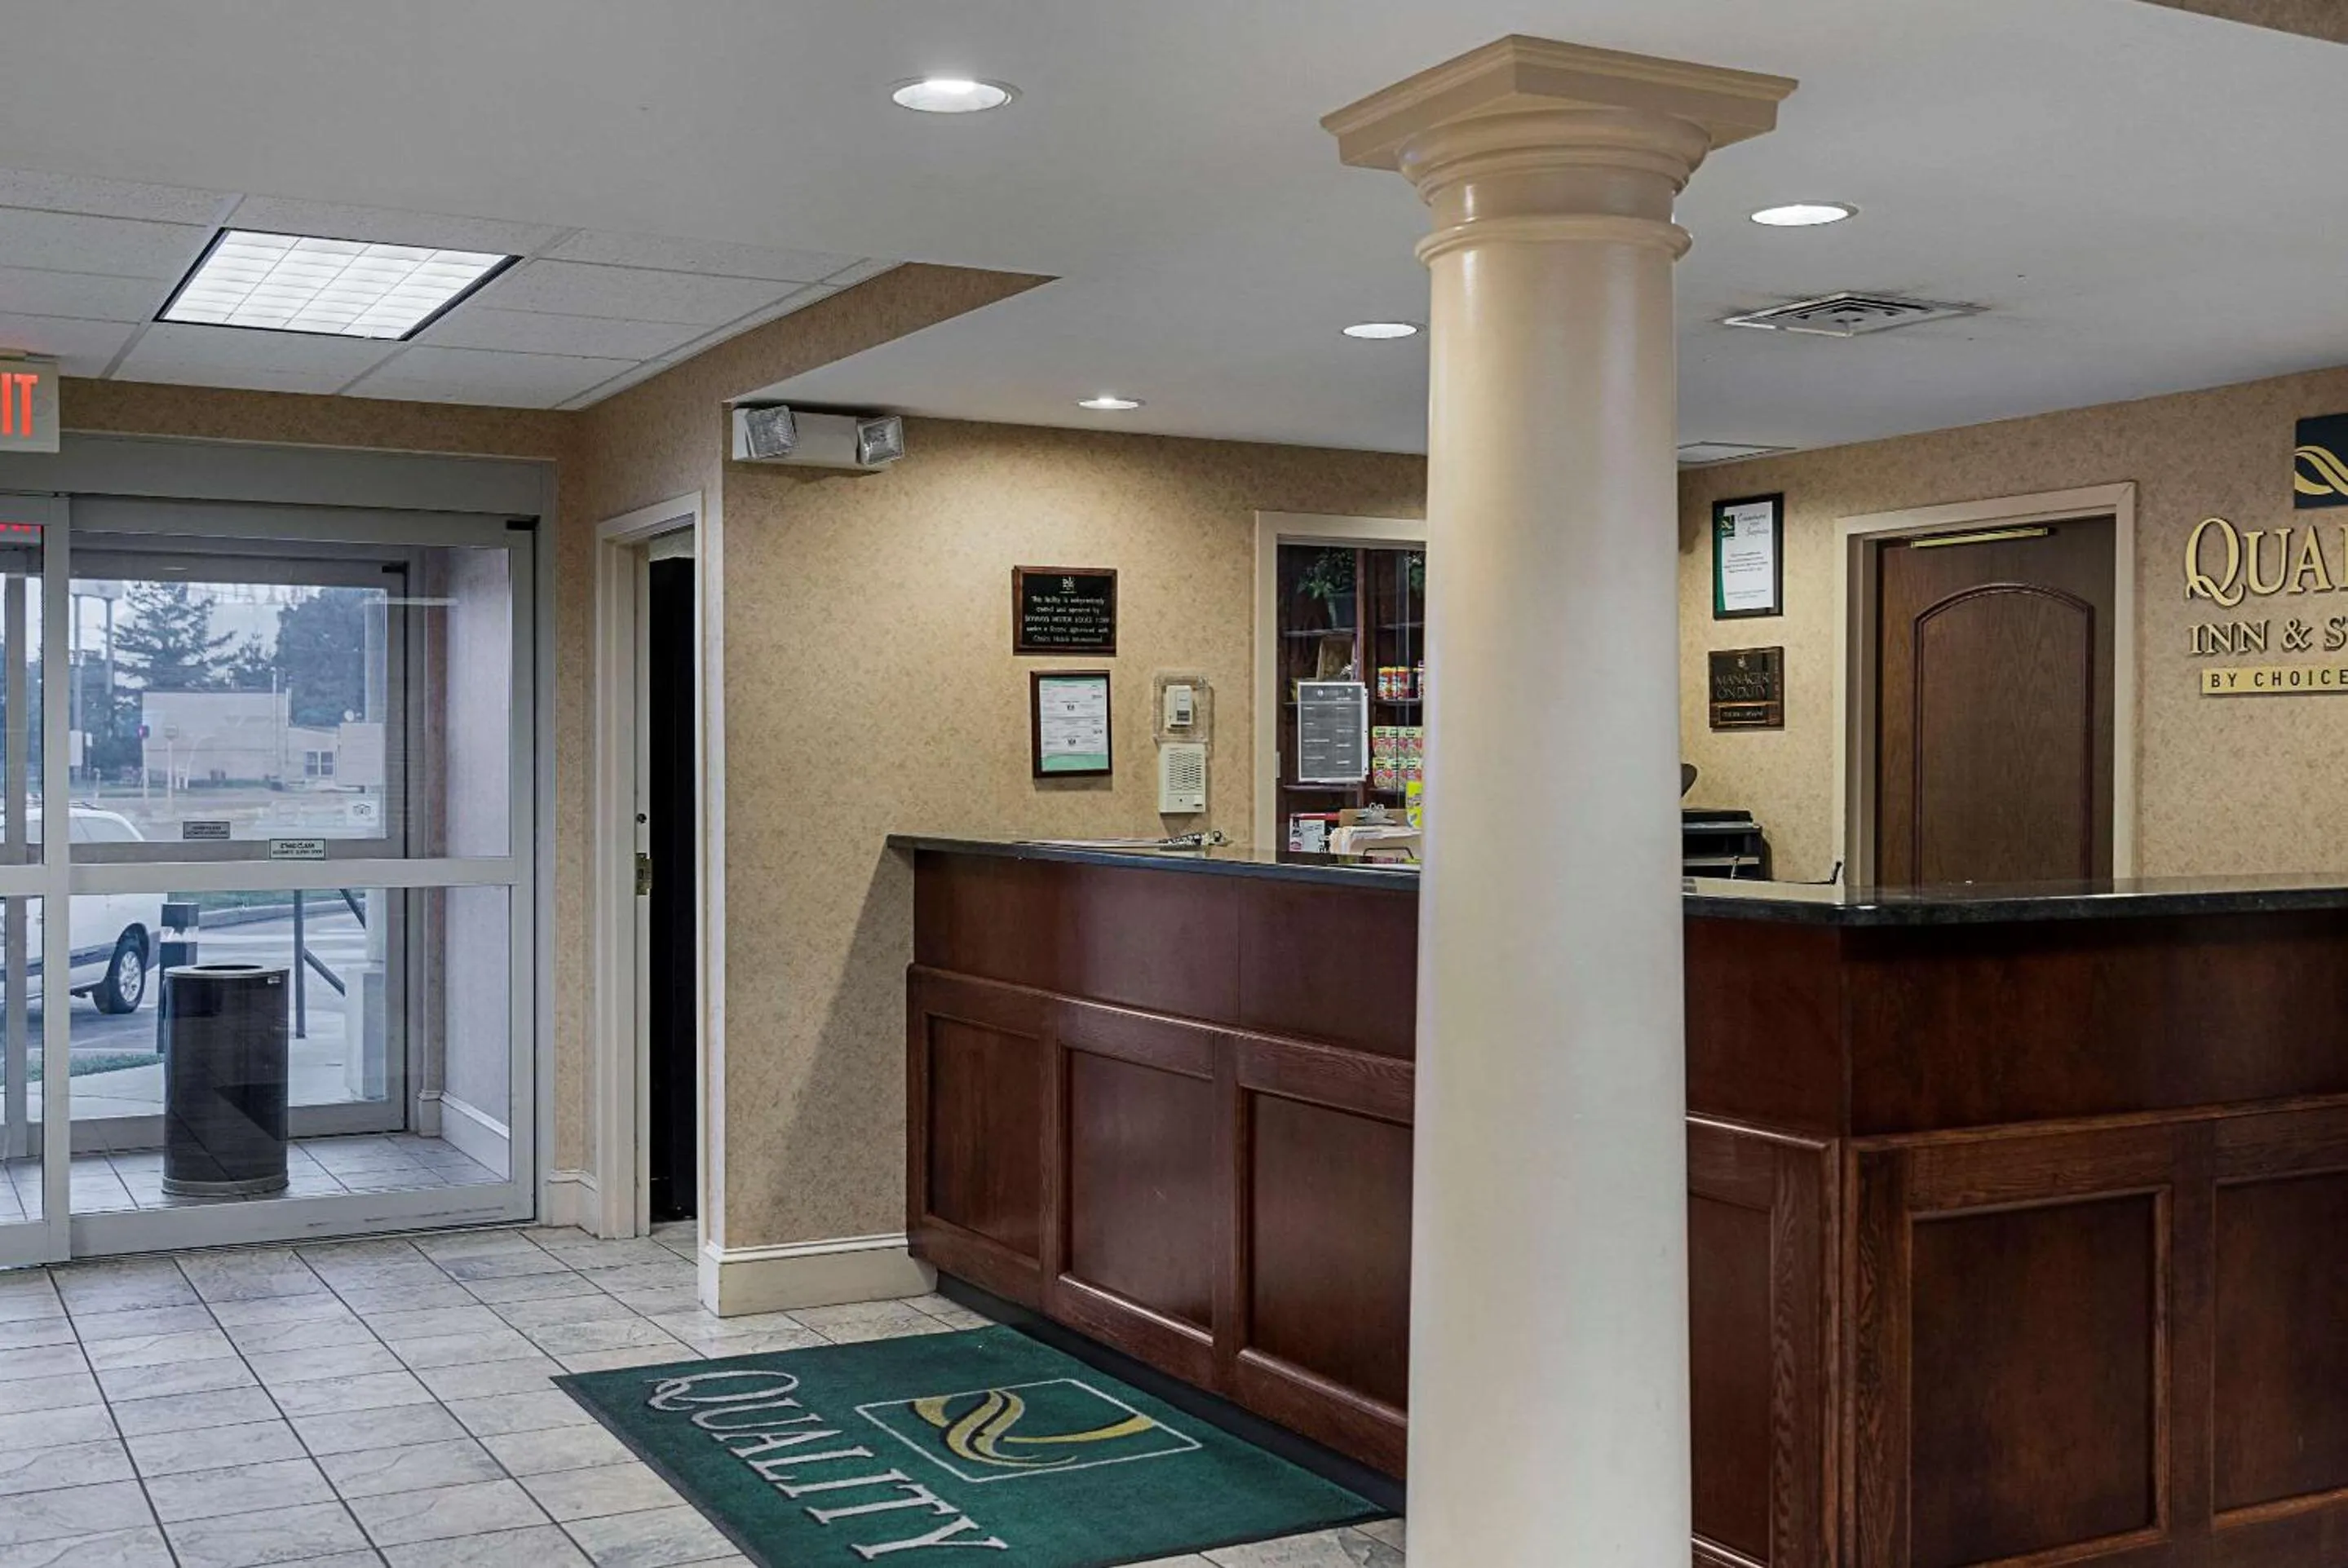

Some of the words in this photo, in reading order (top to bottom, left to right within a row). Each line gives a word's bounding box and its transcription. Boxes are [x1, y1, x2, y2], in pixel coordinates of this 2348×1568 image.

[1, 372, 38, 437] IT
[2189, 620, 2269, 654] INN
[2283, 618, 2312, 651] &
[2324, 616, 2348, 649] S
[2211, 672, 2237, 687] BY
[2253, 669, 2348, 687] CHOICE
[643, 1370, 1009, 1560] QUALITY
